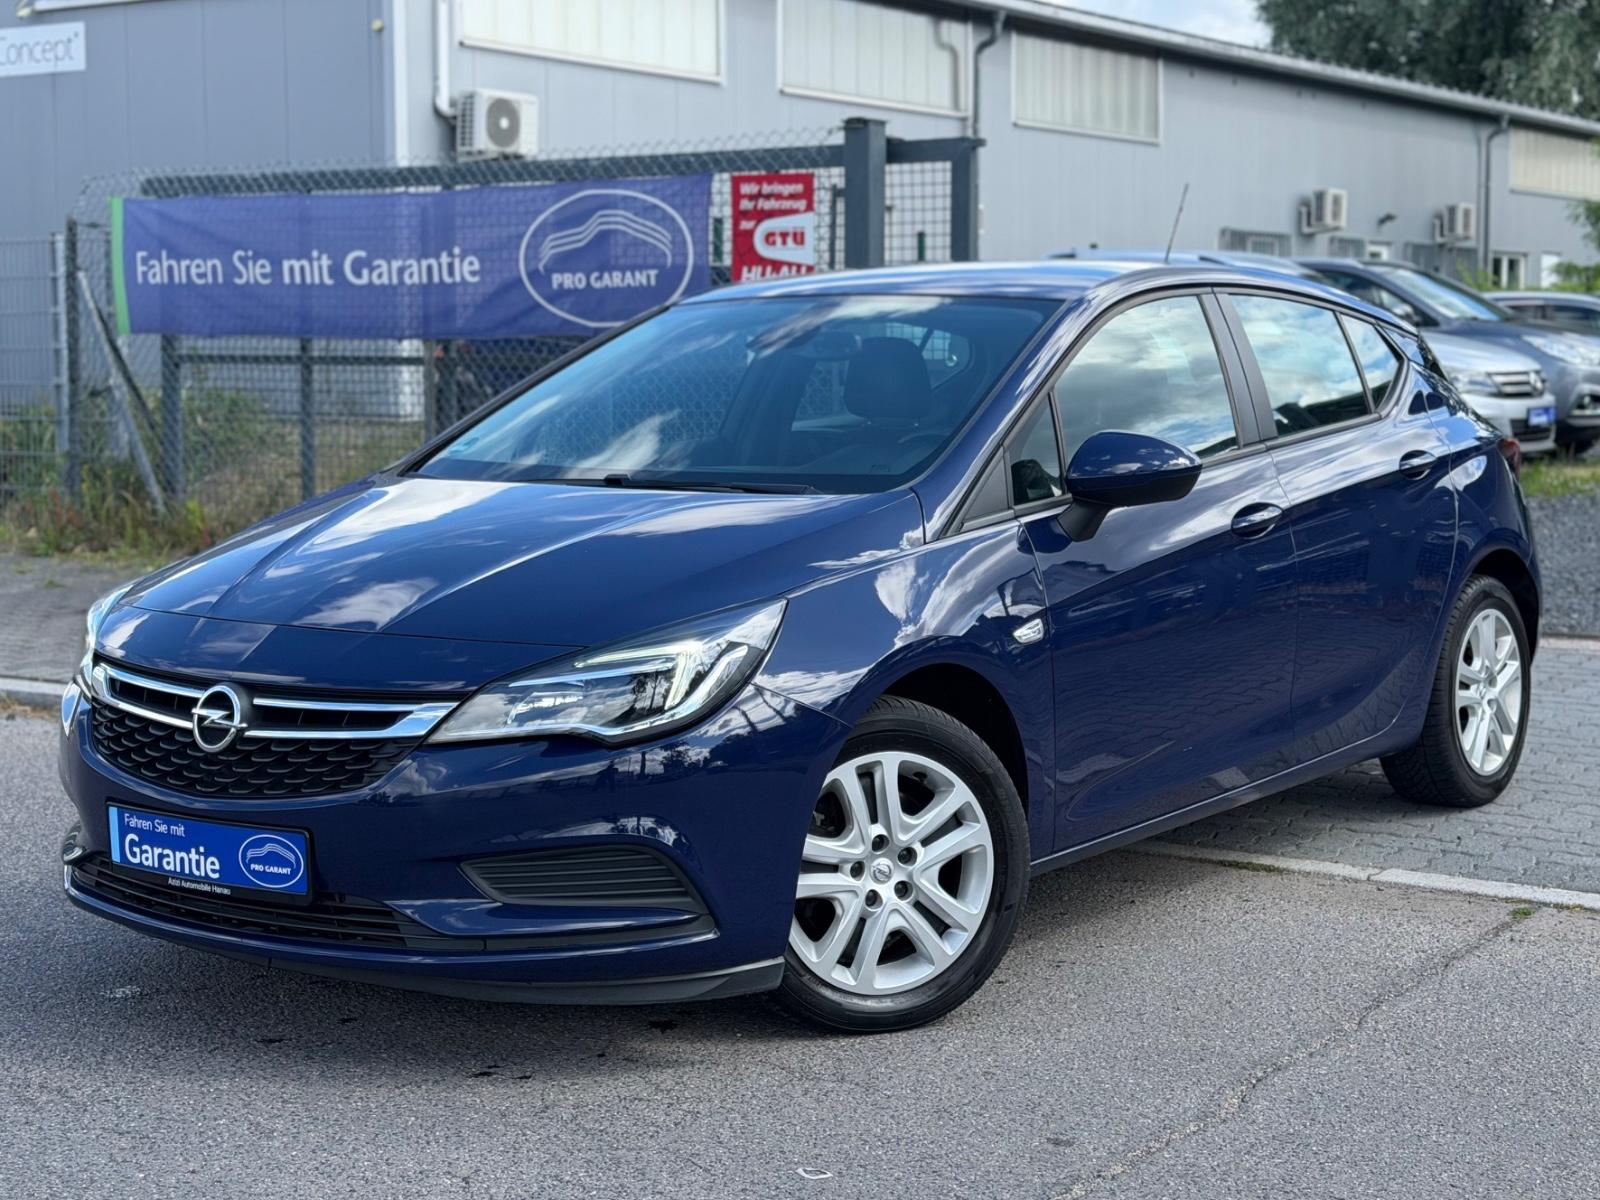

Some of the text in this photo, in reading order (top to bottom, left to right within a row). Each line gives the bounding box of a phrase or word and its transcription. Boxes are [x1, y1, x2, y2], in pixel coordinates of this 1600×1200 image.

[135, 246, 481, 286] Fahren Sie mit Garantie
[551, 268, 660, 290] PRO GARANT
[124, 813, 186, 838] Fahren Sie mit
[125, 833, 220, 878] Garantie
[250, 863, 291, 875] PRO GARANT
[181, 880, 212, 893] Automobile
